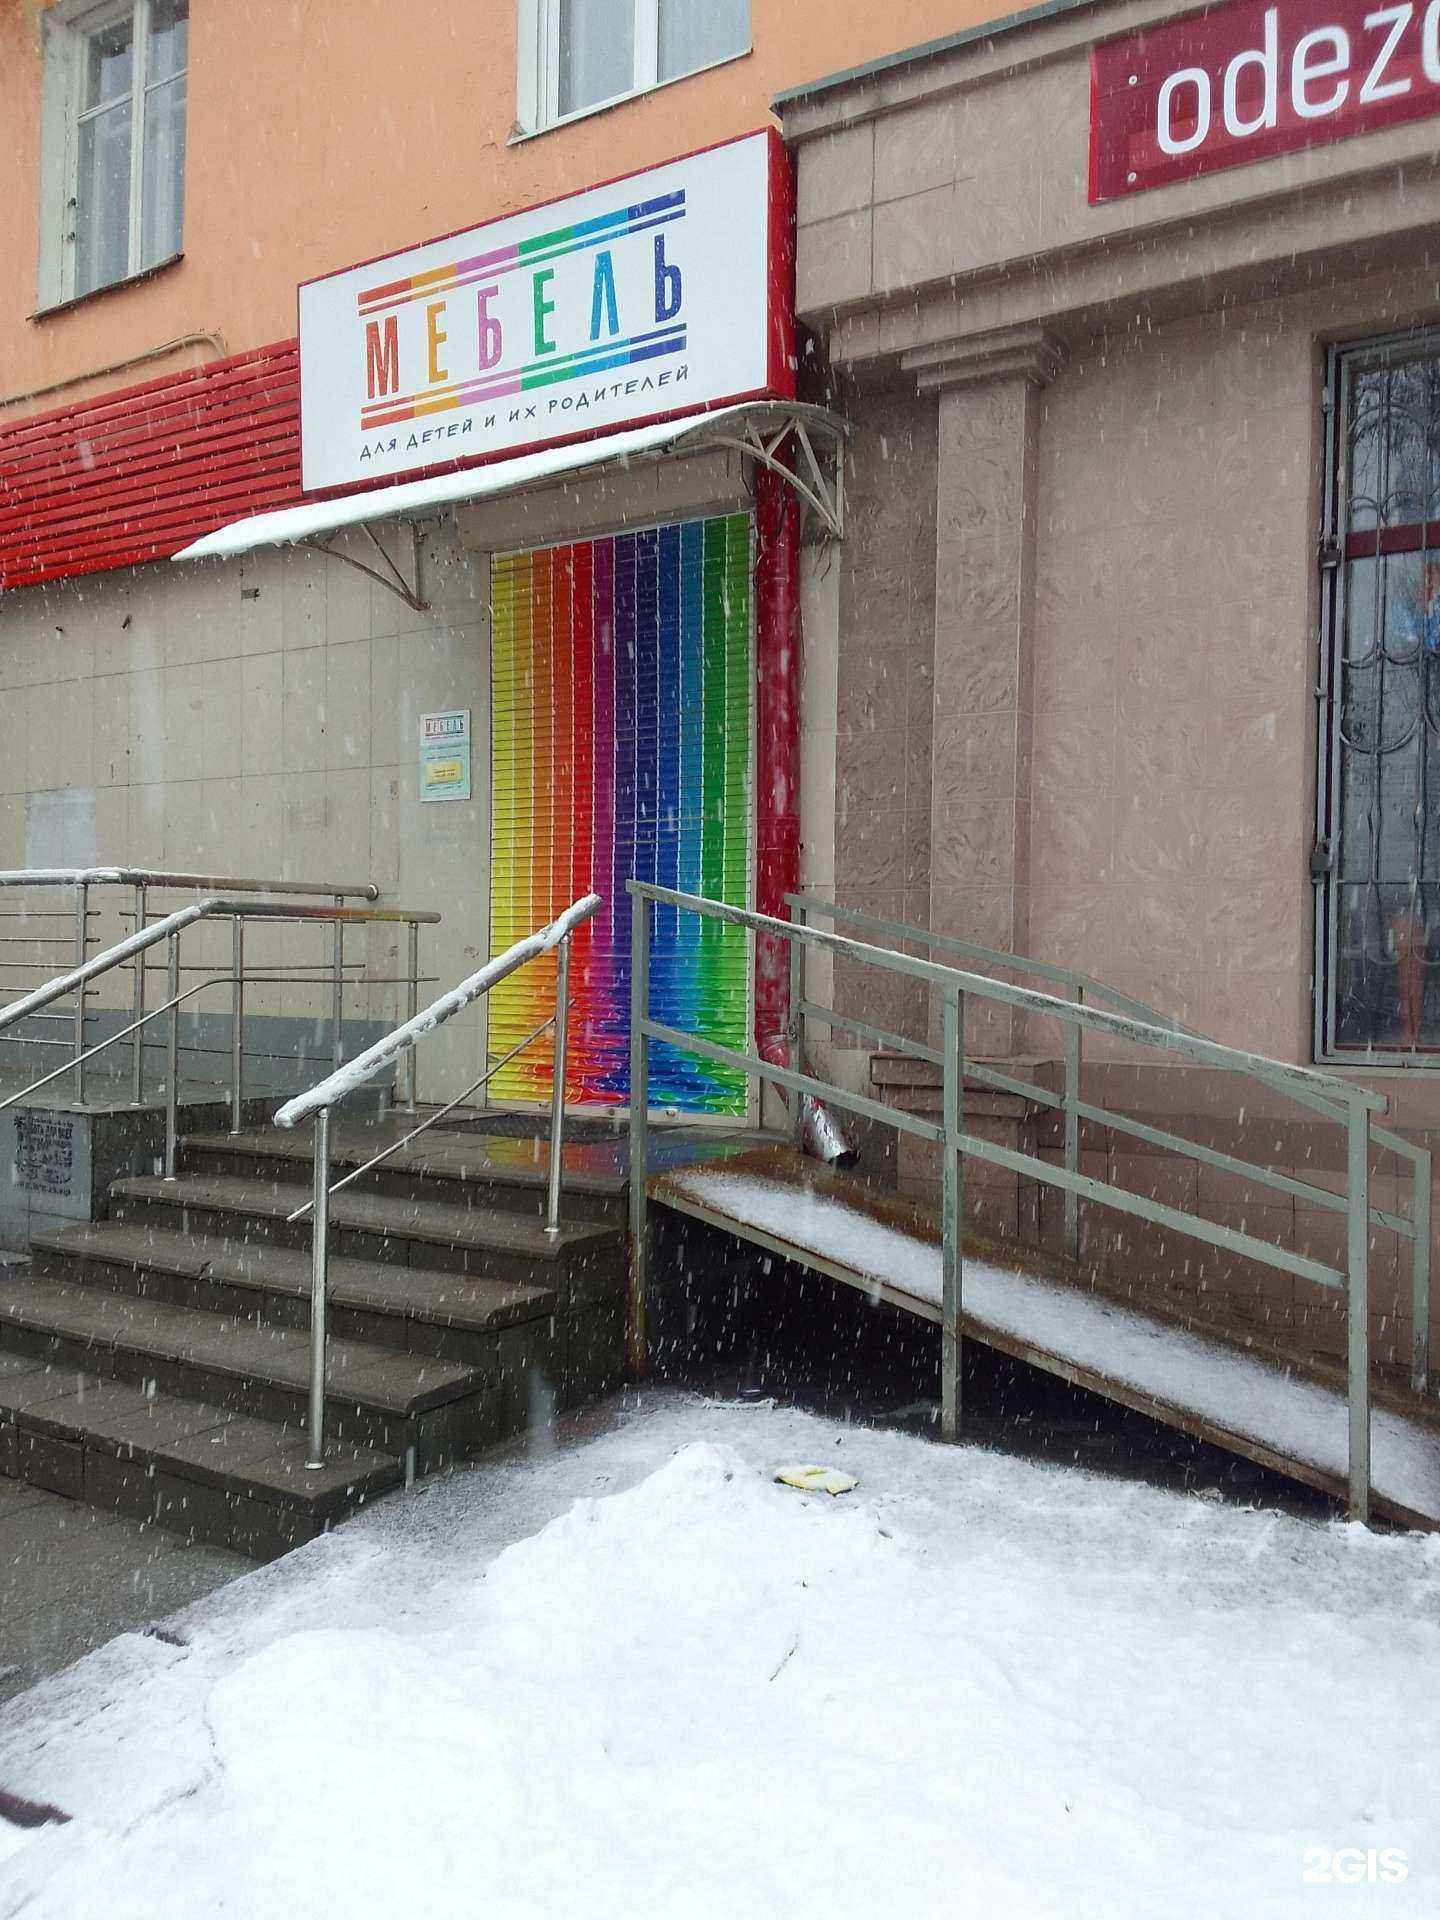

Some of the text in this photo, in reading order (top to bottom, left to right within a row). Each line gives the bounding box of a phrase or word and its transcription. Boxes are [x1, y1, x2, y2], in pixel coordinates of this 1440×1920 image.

[365, 234, 682, 400] МЕБЕЛЬ
[359, 364, 689, 462] ДЛЯ ДЕТЕЙ И ИХ РОДИТЕЛЕЙ
